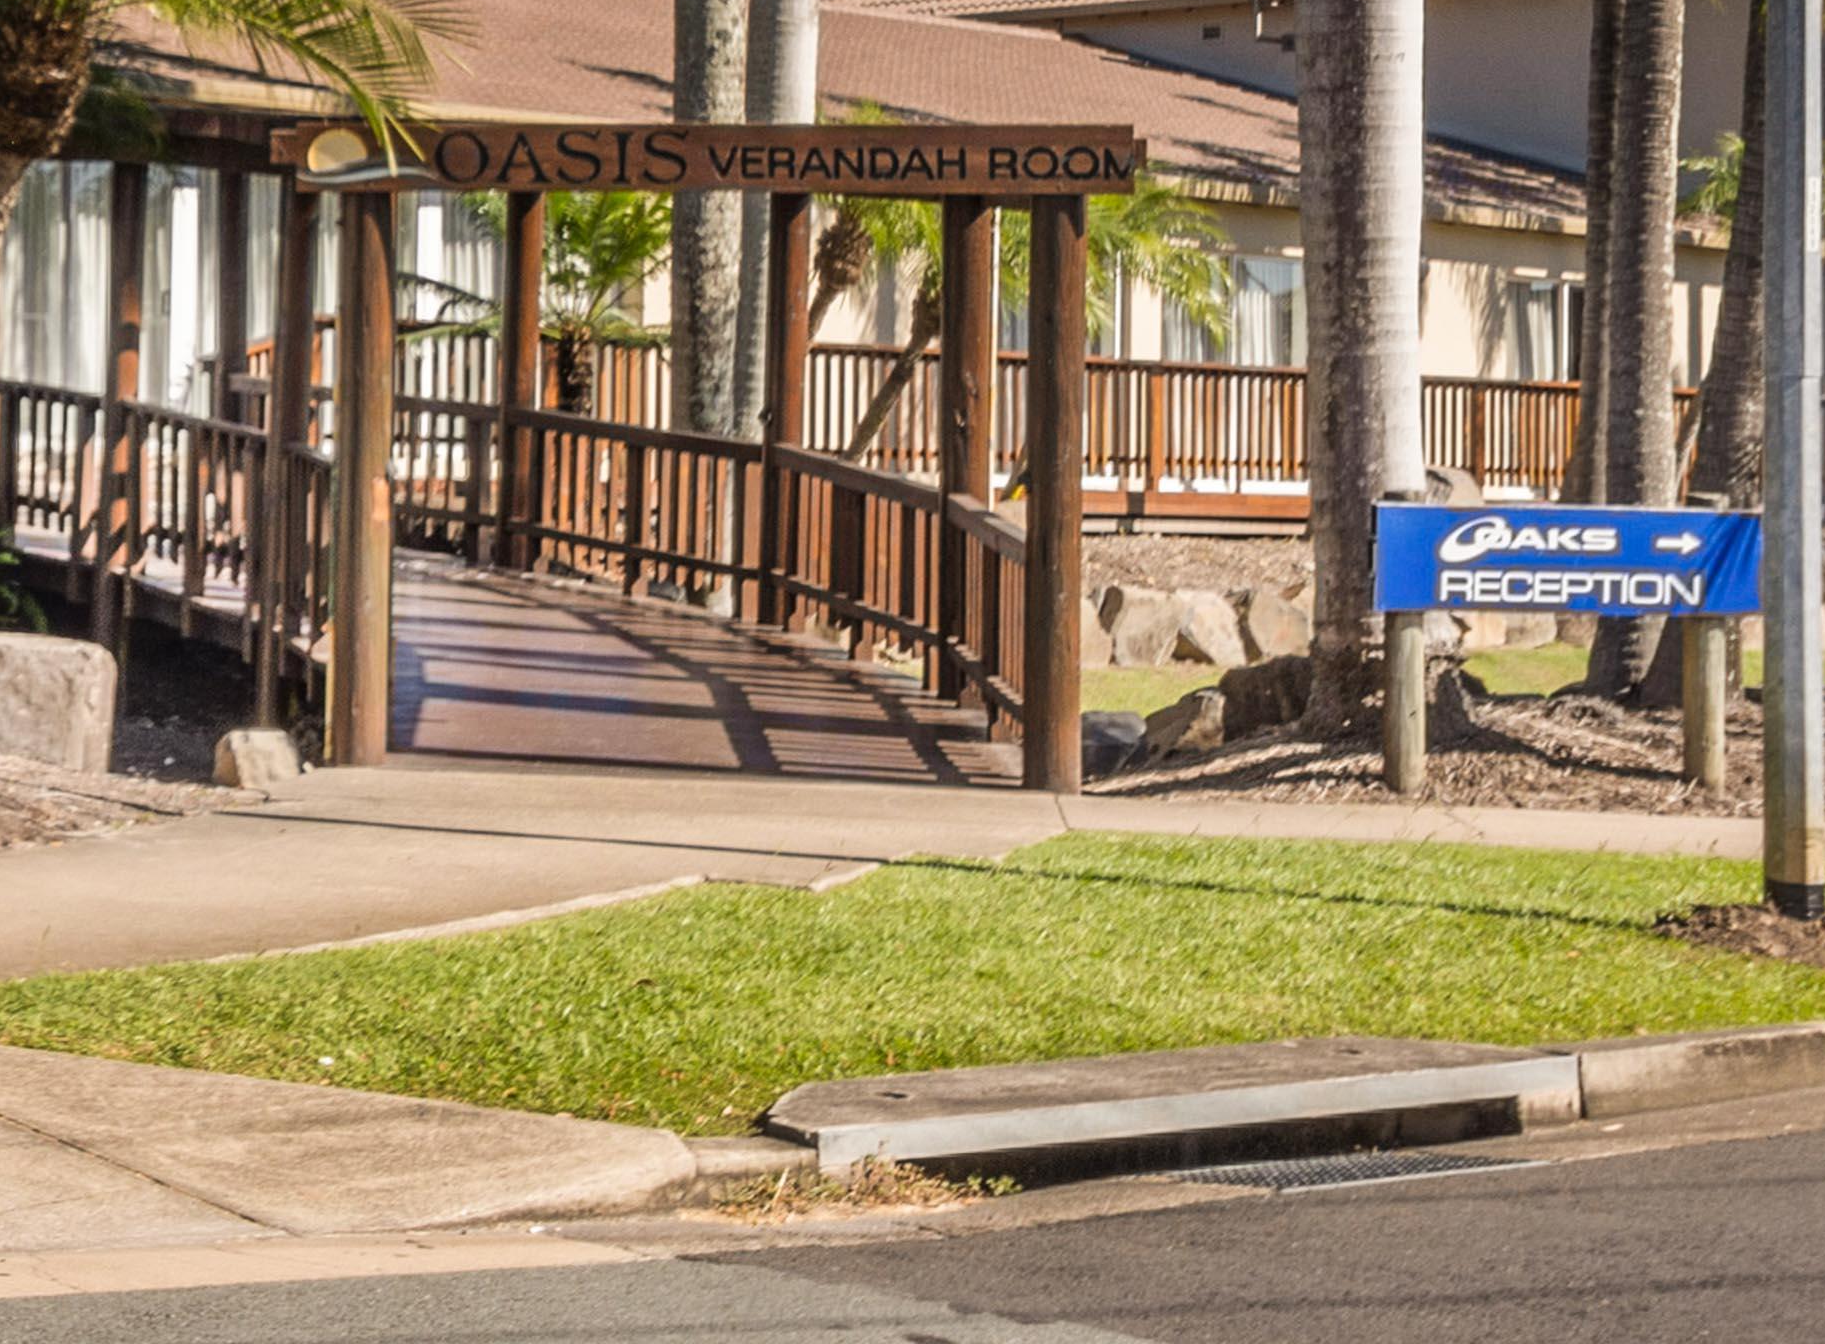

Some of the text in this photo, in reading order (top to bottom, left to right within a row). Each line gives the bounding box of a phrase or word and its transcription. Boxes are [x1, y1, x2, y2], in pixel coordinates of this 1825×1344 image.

[434, 129, 1135, 185] OASIS VERANDAH ROOM
[1472, 523, 1618, 553] OAKS
[1439, 569, 1703, 606] RECEPTION
